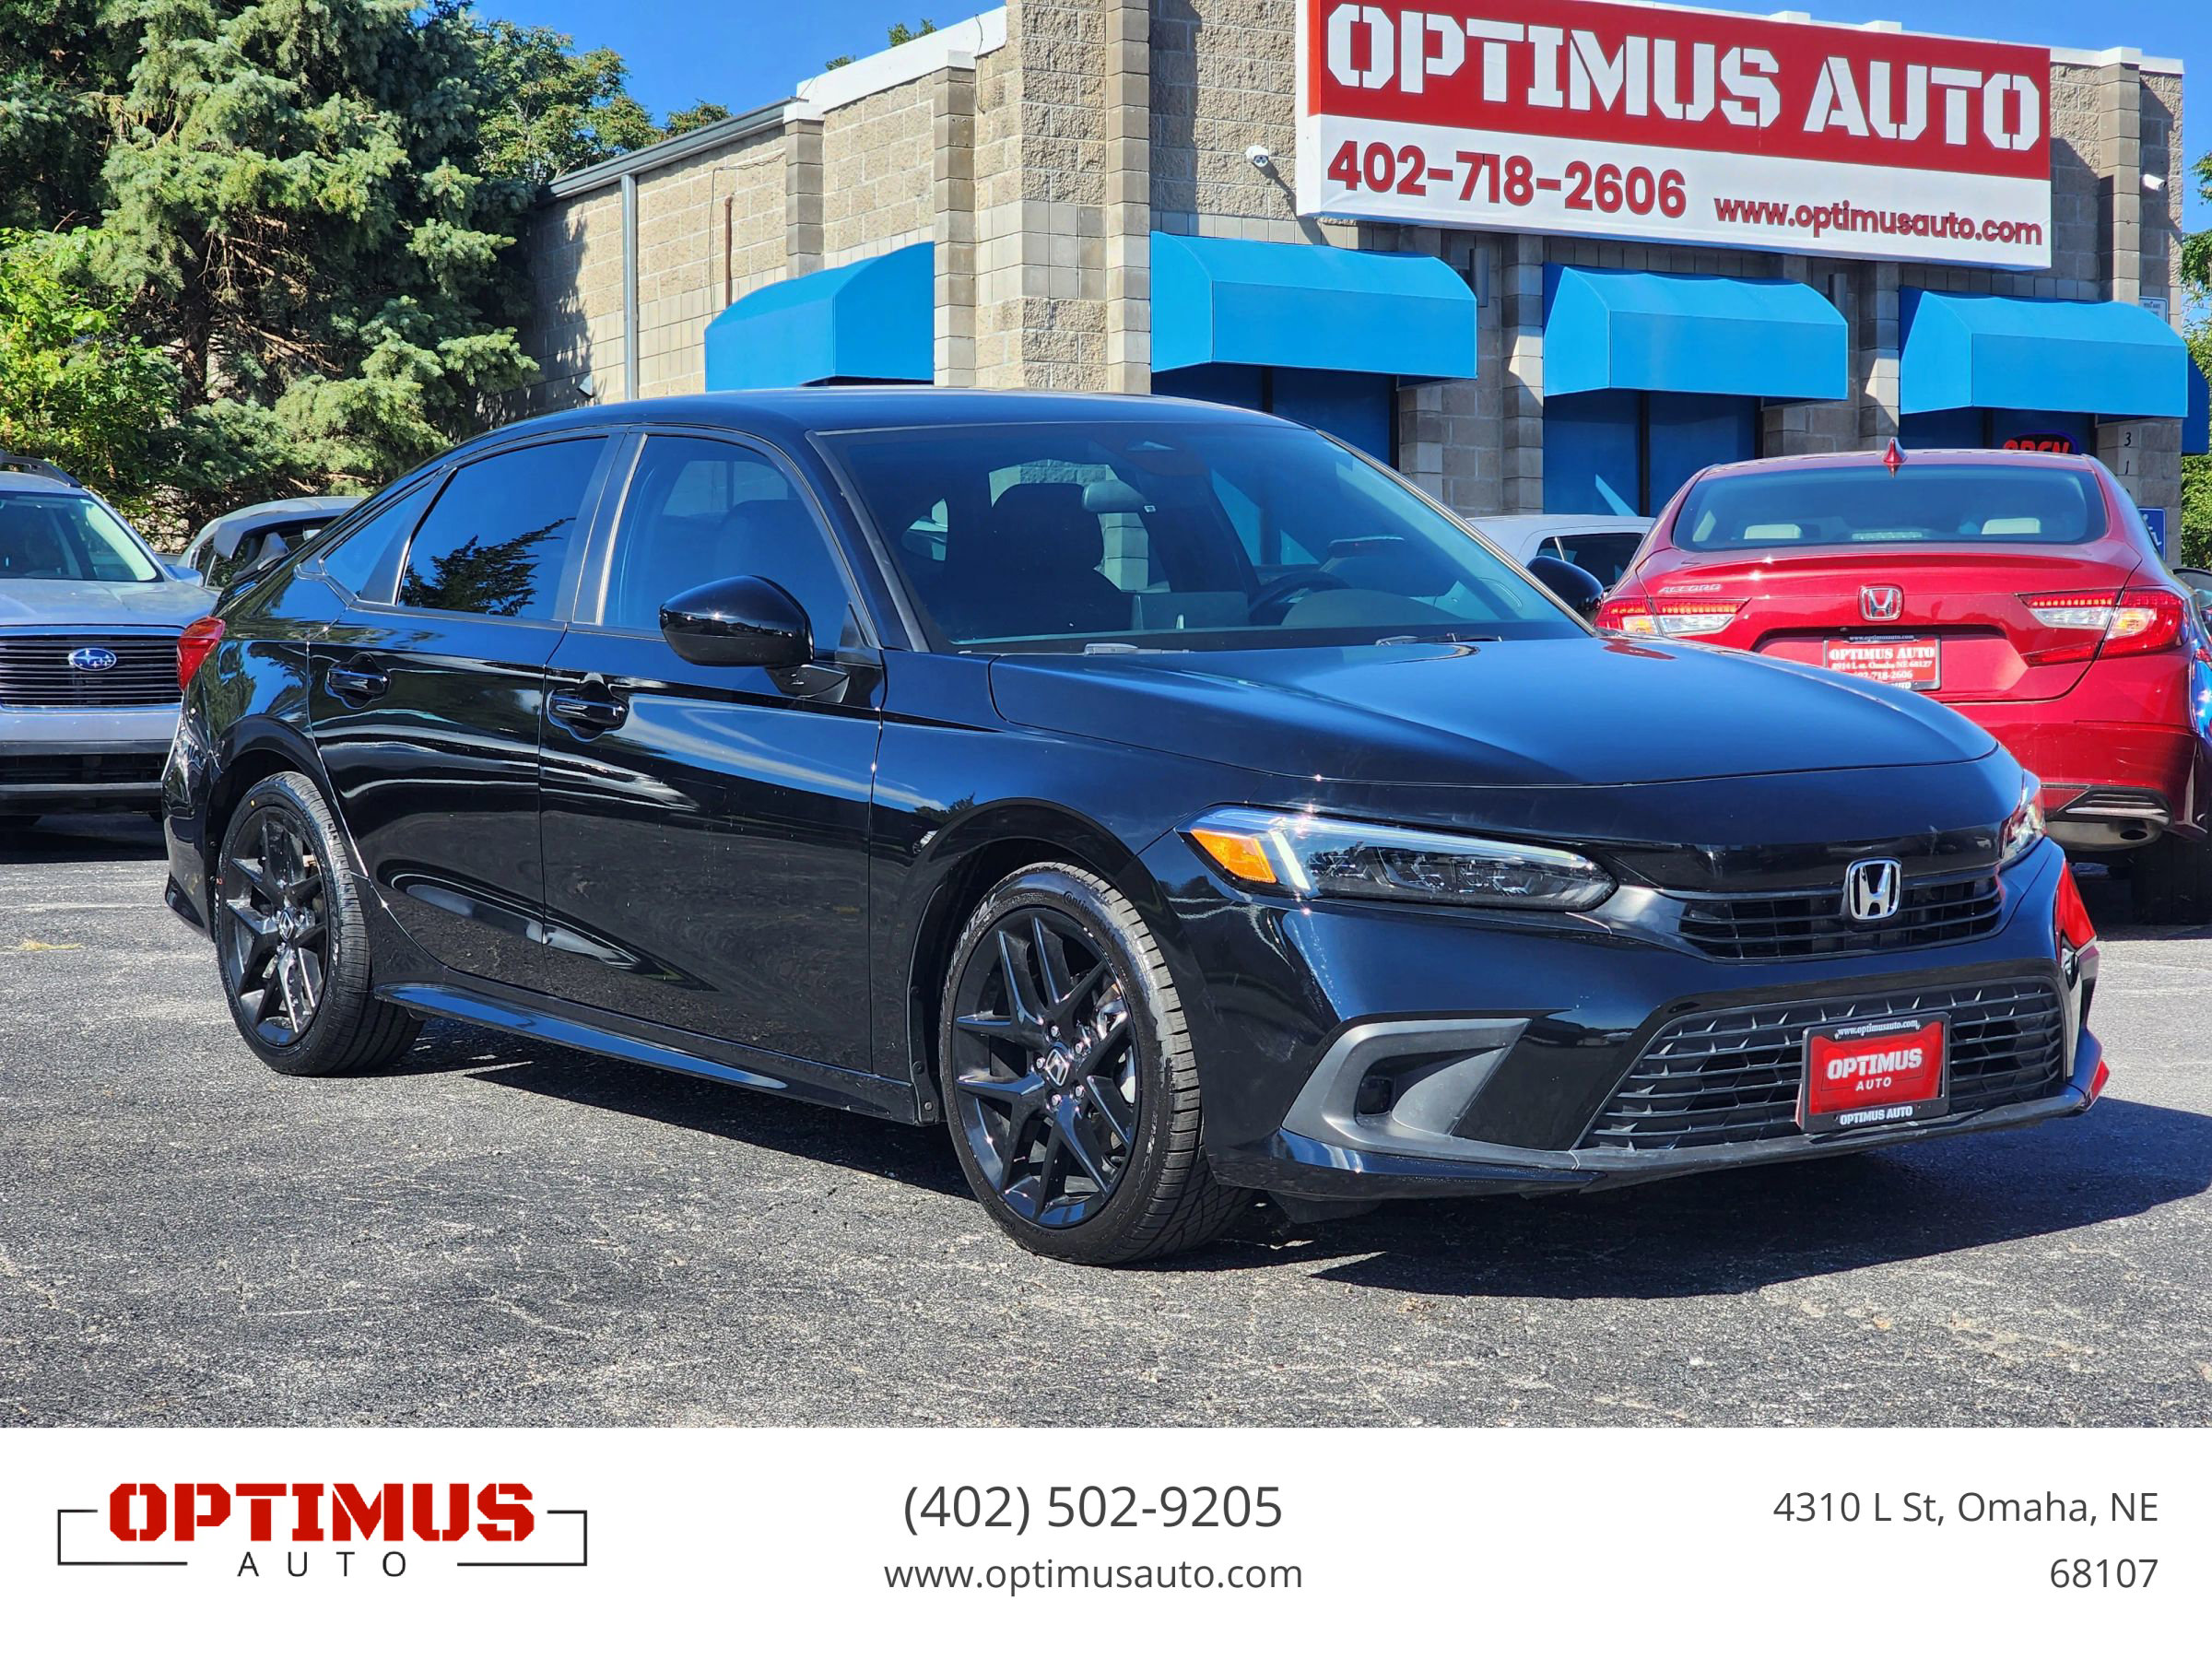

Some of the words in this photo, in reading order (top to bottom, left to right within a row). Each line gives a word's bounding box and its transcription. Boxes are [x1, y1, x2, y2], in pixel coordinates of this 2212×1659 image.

[1327, 3, 1781, 128] OPTIMUS
[1803, 55, 2040, 151] AUTO
[1327, 140, 1687, 218] 402-718-2606
[1713, 197, 2042, 245] www.optimusauto.com
[1829, 648, 1894, 660] OPTIMUS
[1897, 647, 1936, 658] AUTO
[1837, 1019, 1918, 1037] www.optimusauto.com
[1827, 1047, 1924, 1080] OPTIMUS
[1854, 1077, 1892, 1091] AUTO
[1839, 1111, 1886, 1125] OPTIMUS
[1886, 1105, 1913, 1119] AUTO
